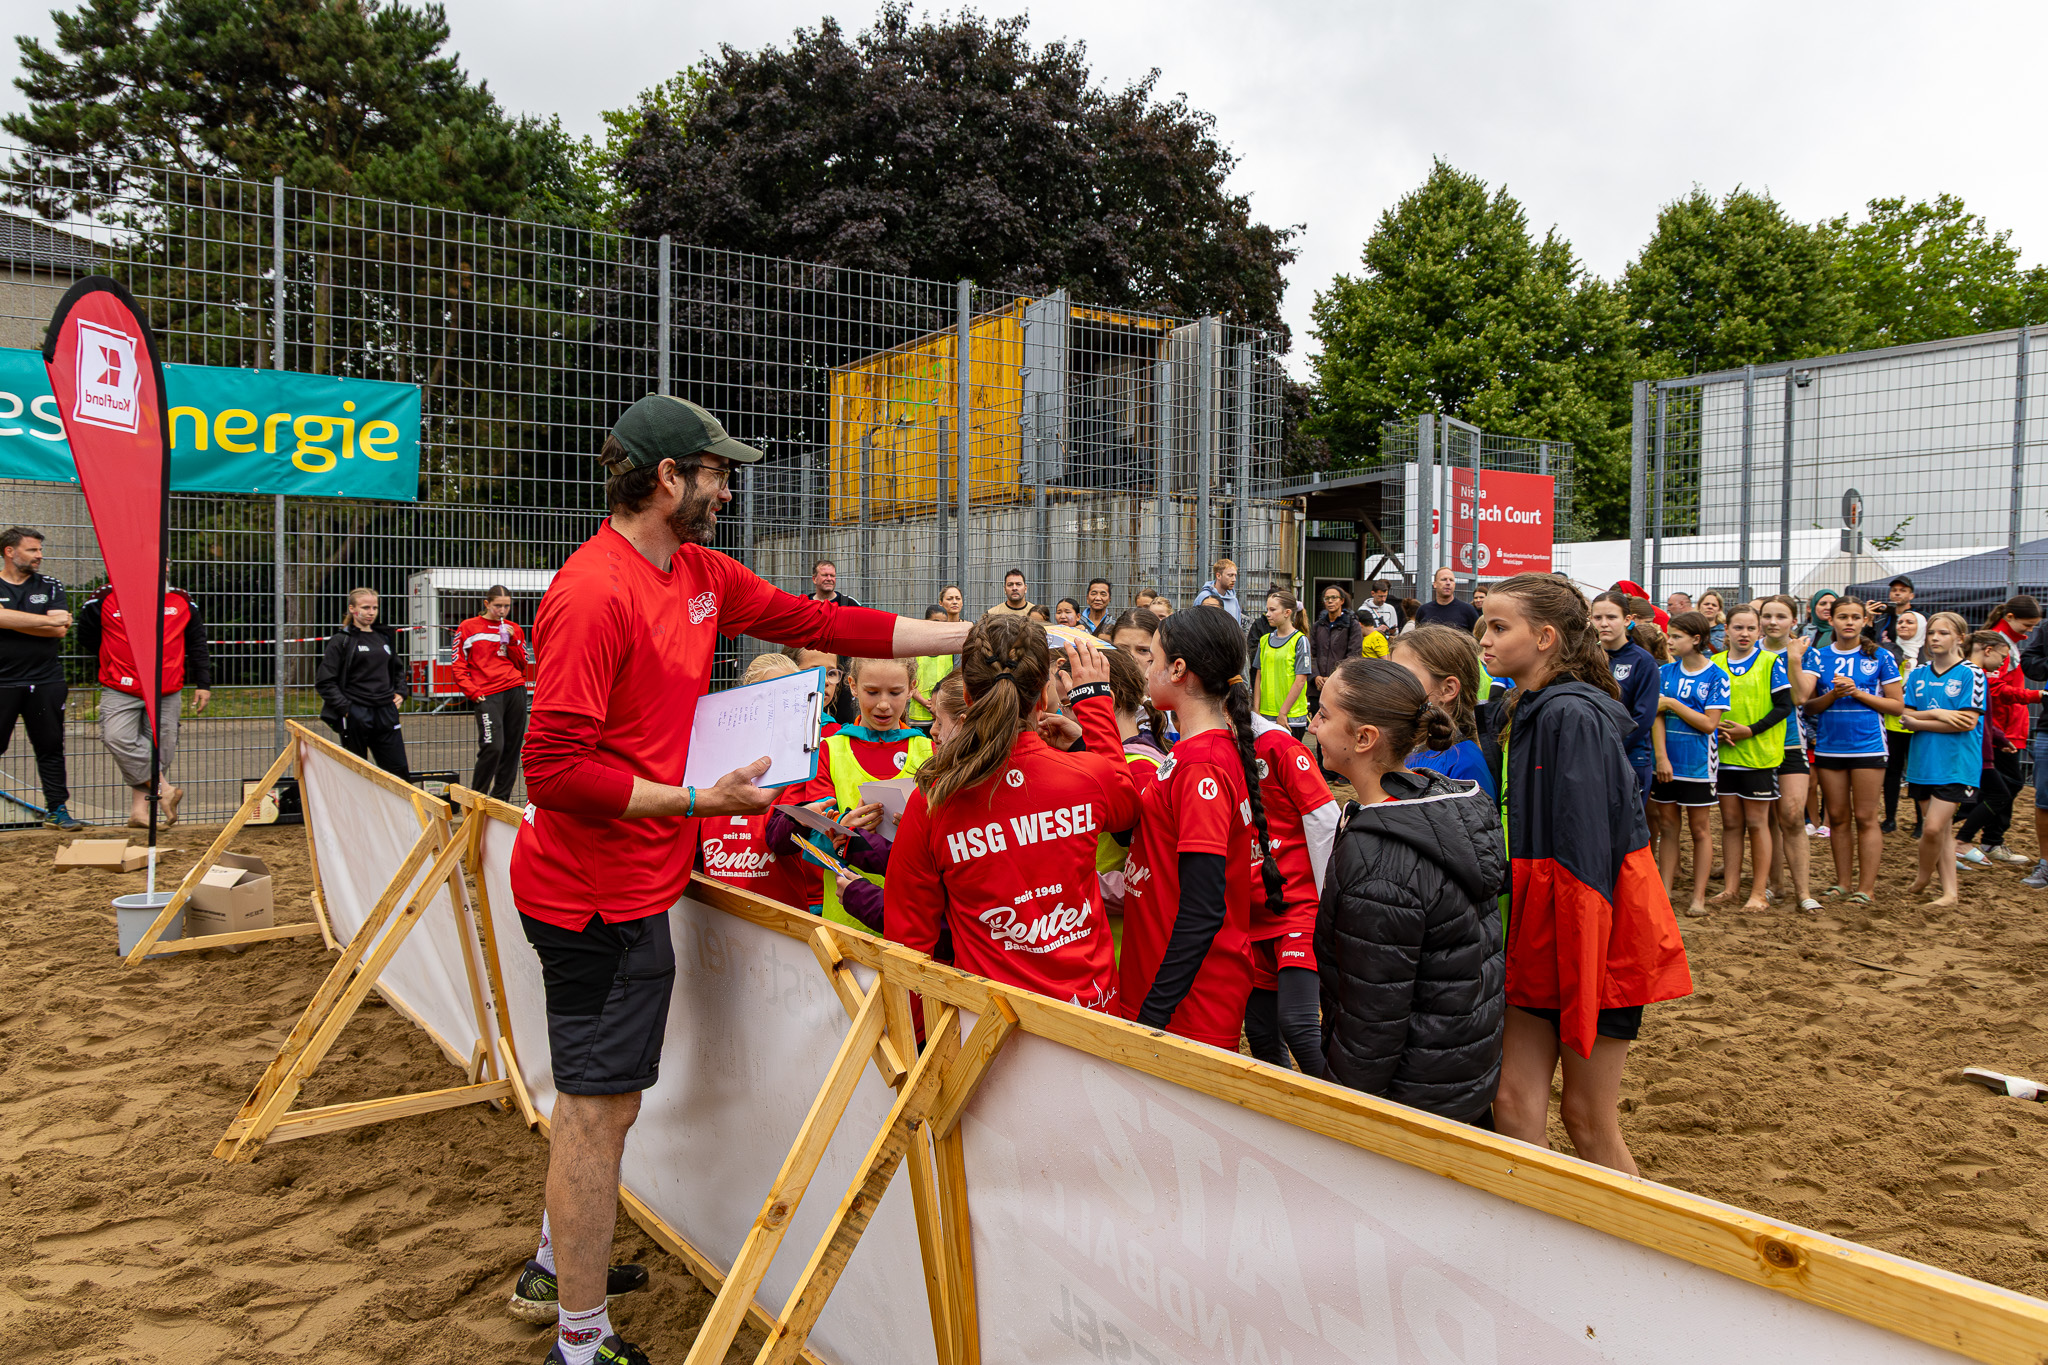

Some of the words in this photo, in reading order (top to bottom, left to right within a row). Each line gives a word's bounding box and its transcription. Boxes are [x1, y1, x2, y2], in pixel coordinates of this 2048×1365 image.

[1505, 506, 1542, 525] Court
[1834, 656, 1855, 677] 21
[1676, 677, 1695, 698] 15
[1915, 679, 1926, 697] 2
[481, 713, 493, 744] Kempa
[723, 832, 738, 840] seit
[946, 822, 1007, 864] HSG
[1010, 803, 1097, 847] WESEL
[703, 838, 777, 870] Benter
[709, 868, 770, 878] Backmanufaktur
[1014, 888, 1033, 905] seit
[1035, 883, 1063, 899] 1948
[978, 898, 1093, 945] Benter
[1004, 926, 1092, 954] Backmanufaktur
